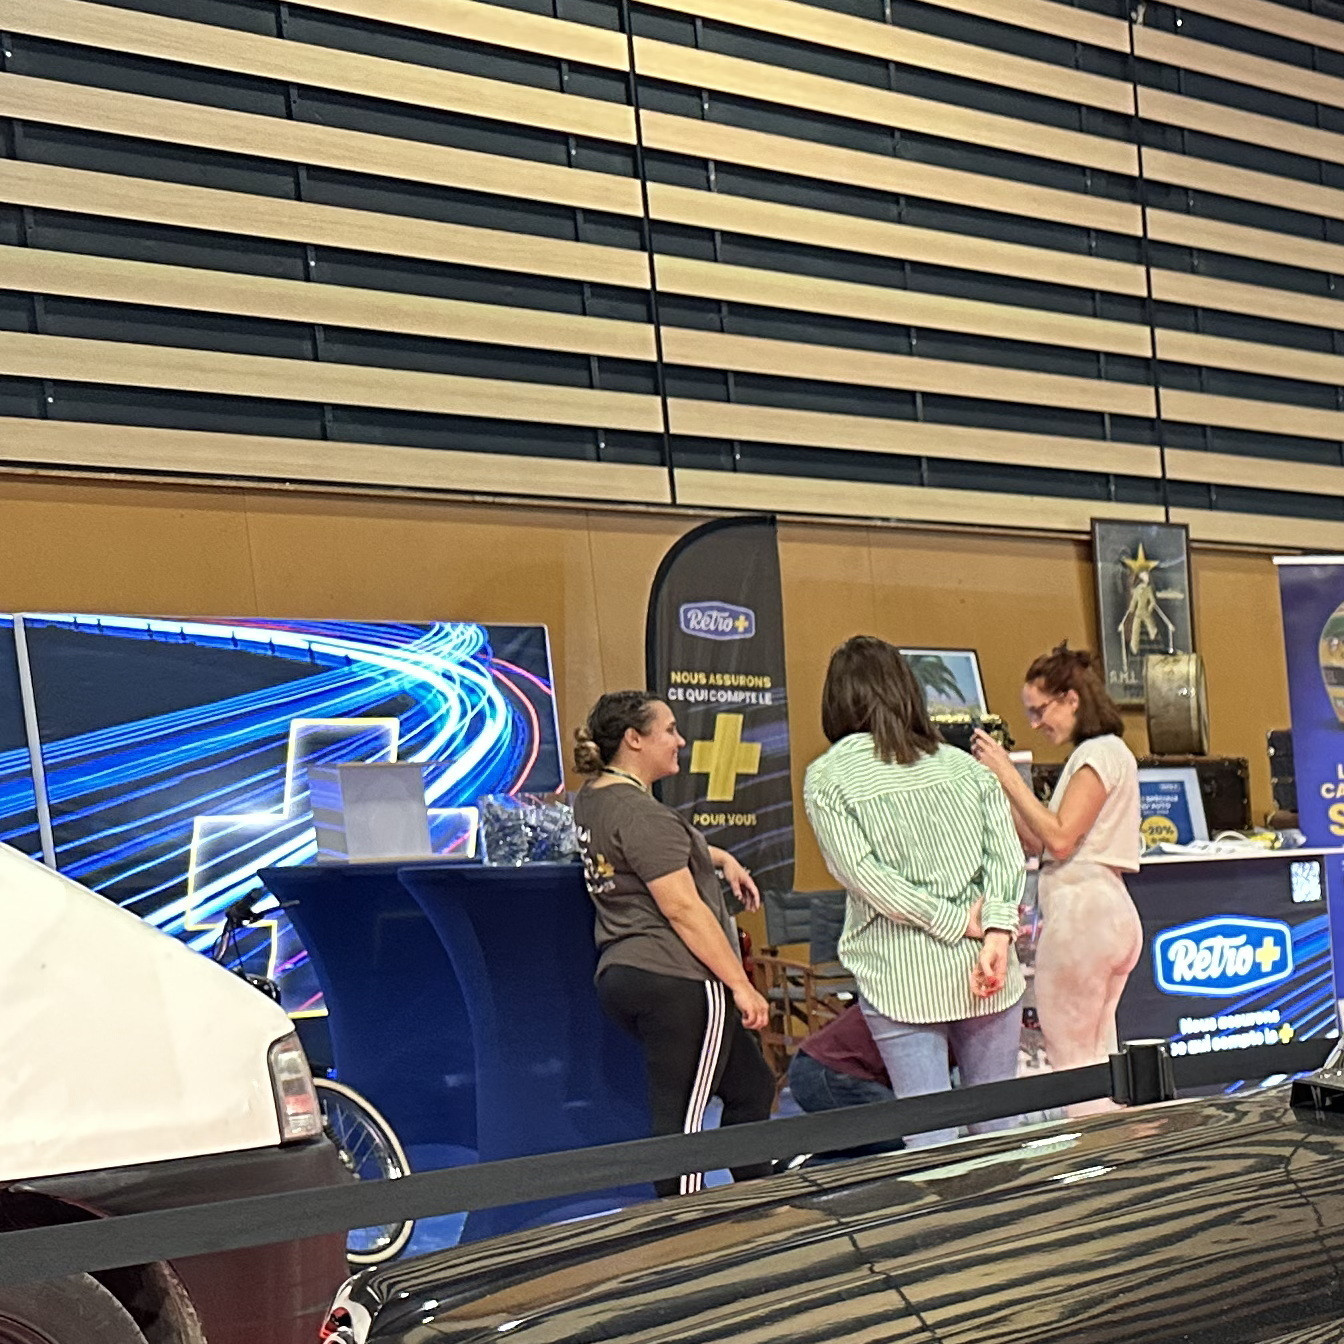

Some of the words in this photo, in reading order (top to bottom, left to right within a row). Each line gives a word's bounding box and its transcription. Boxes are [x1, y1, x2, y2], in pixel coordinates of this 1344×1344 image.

[670, 671, 706, 685] NOUS
[709, 672, 772, 688] ASSURONS
[668, 688, 685, 700] CE
[686, 689, 708, 701] QUI
[709, 690, 757, 704] COMPTE
[758, 692, 773, 705] LE
[693, 813, 726, 826] POUR
[727, 813, 757, 826] VOUS
